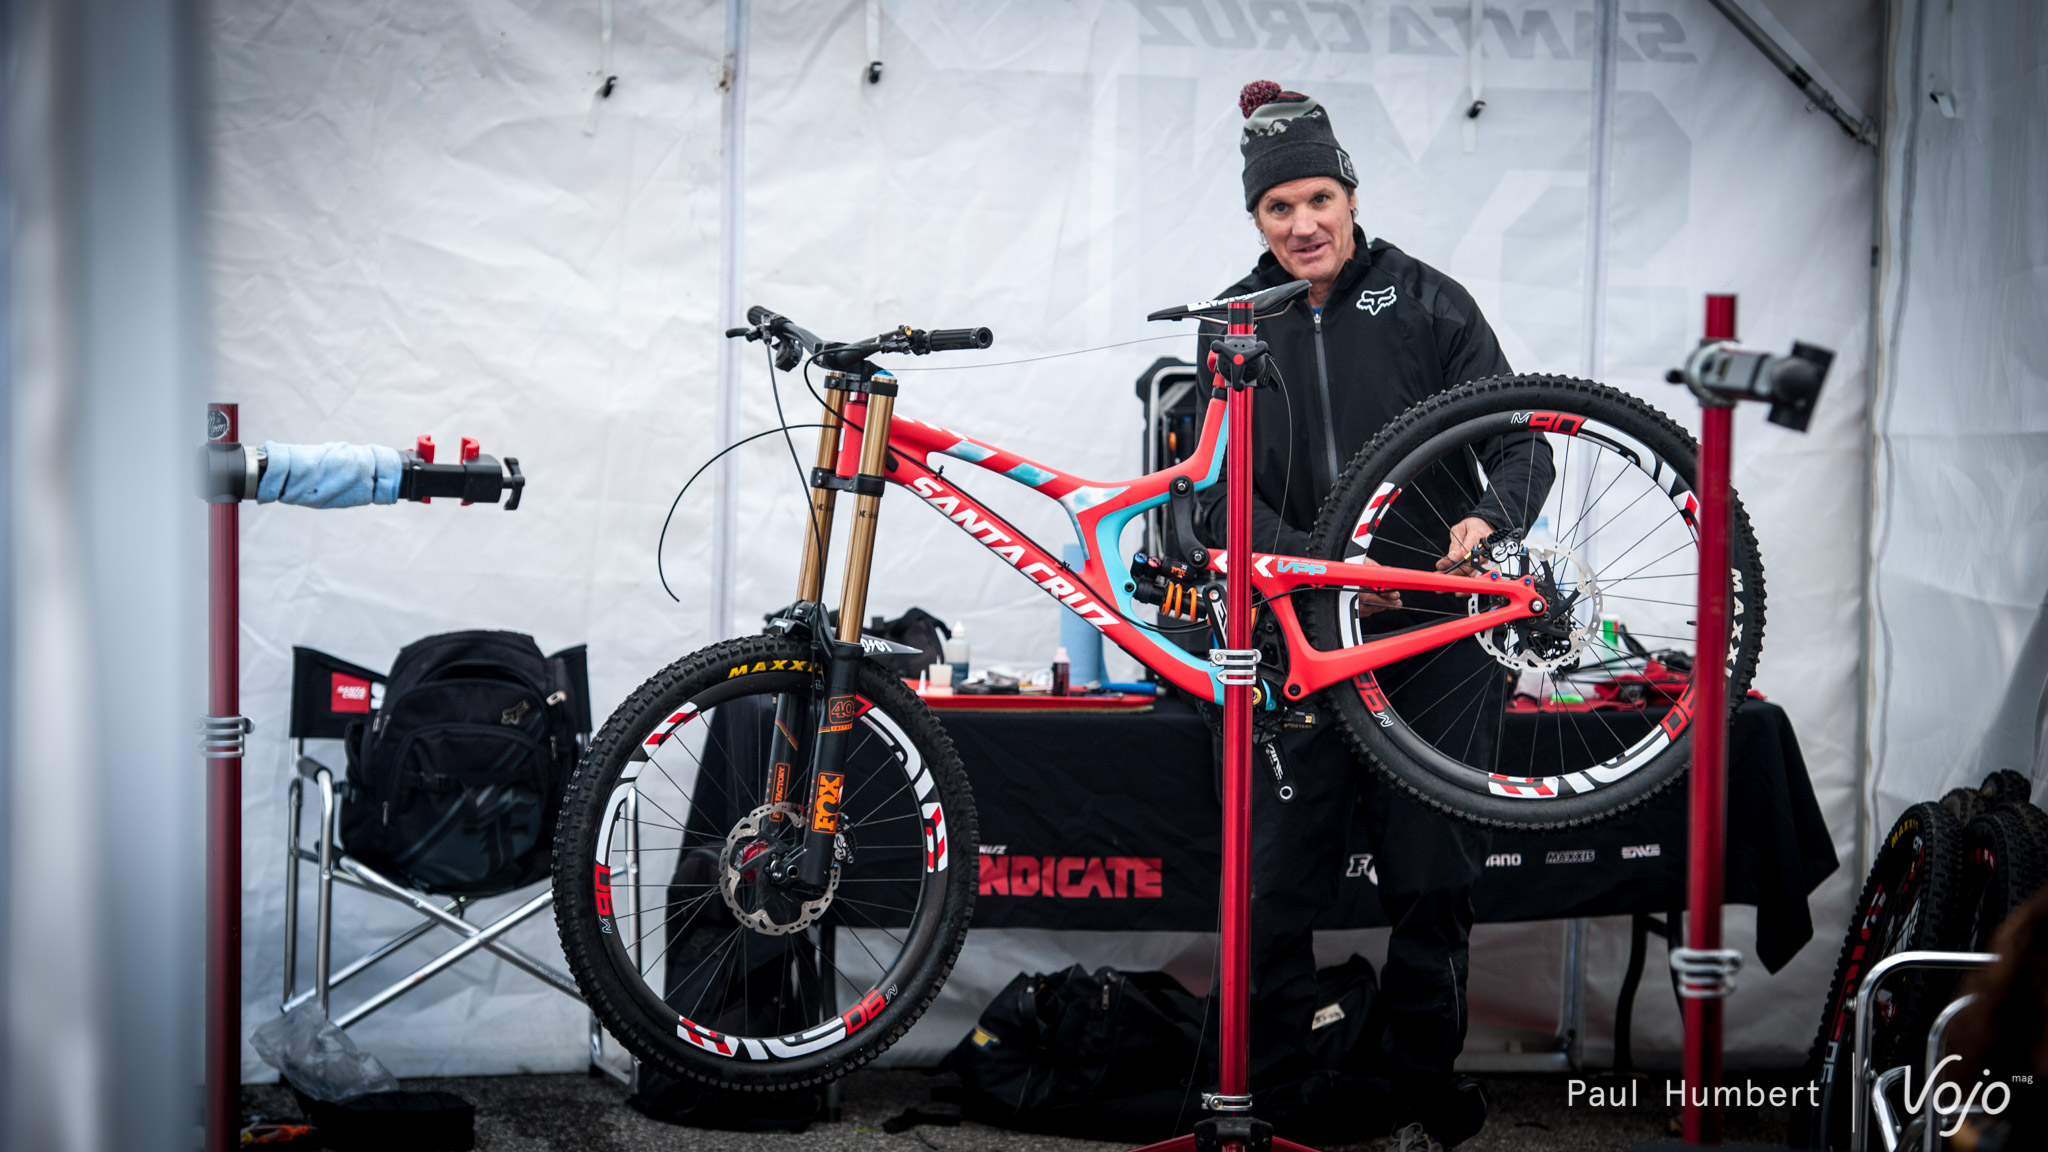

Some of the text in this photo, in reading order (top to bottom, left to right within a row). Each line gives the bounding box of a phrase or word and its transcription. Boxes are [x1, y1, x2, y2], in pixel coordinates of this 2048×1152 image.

[904, 476, 1026, 567] SANTA
[1020, 562, 1121, 633] CRUZ
[1724, 567, 1744, 678] MAXXI
[831, 700, 853, 718] 40
[813, 774, 841, 832] FOX
